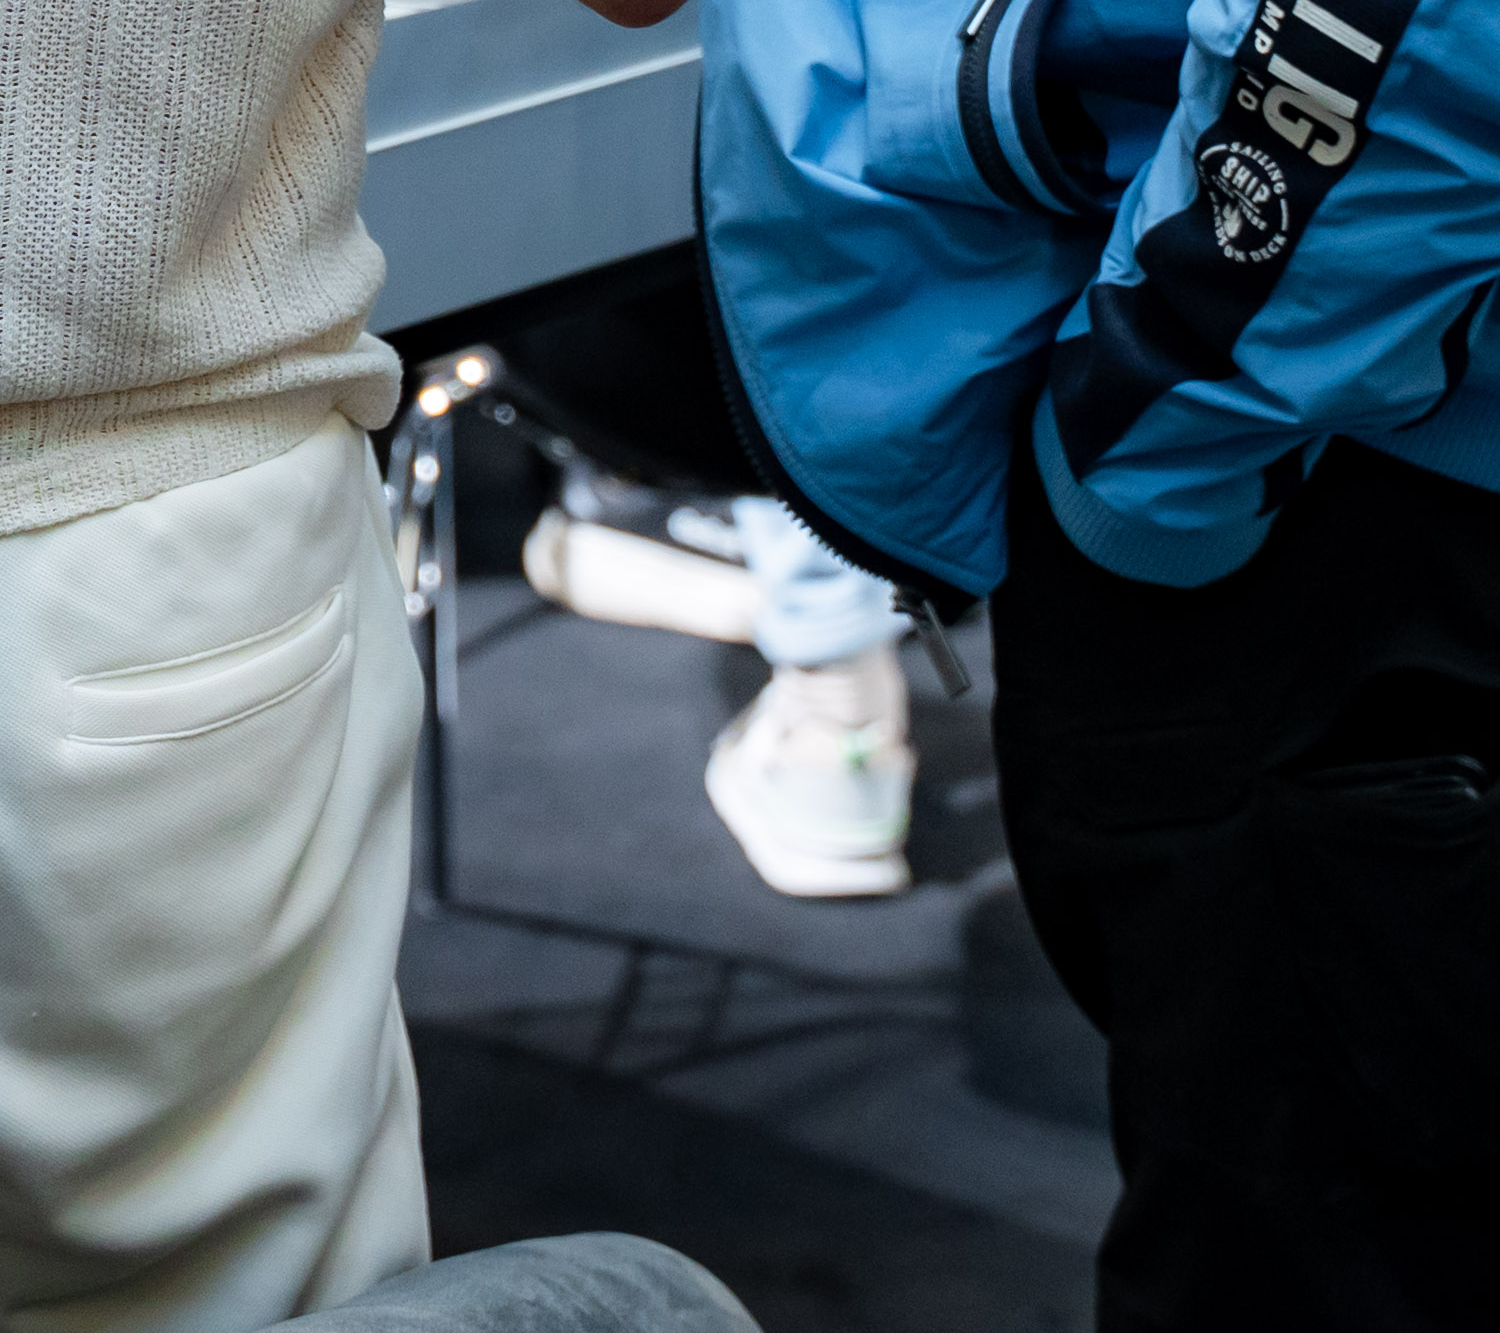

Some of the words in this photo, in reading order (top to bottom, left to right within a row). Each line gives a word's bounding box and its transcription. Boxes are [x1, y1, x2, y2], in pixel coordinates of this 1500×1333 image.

[1220, 156, 1272, 203] SHIP
[1229, 141, 1288, 195] SAILING
[1249, 233, 1288, 263] DECK
